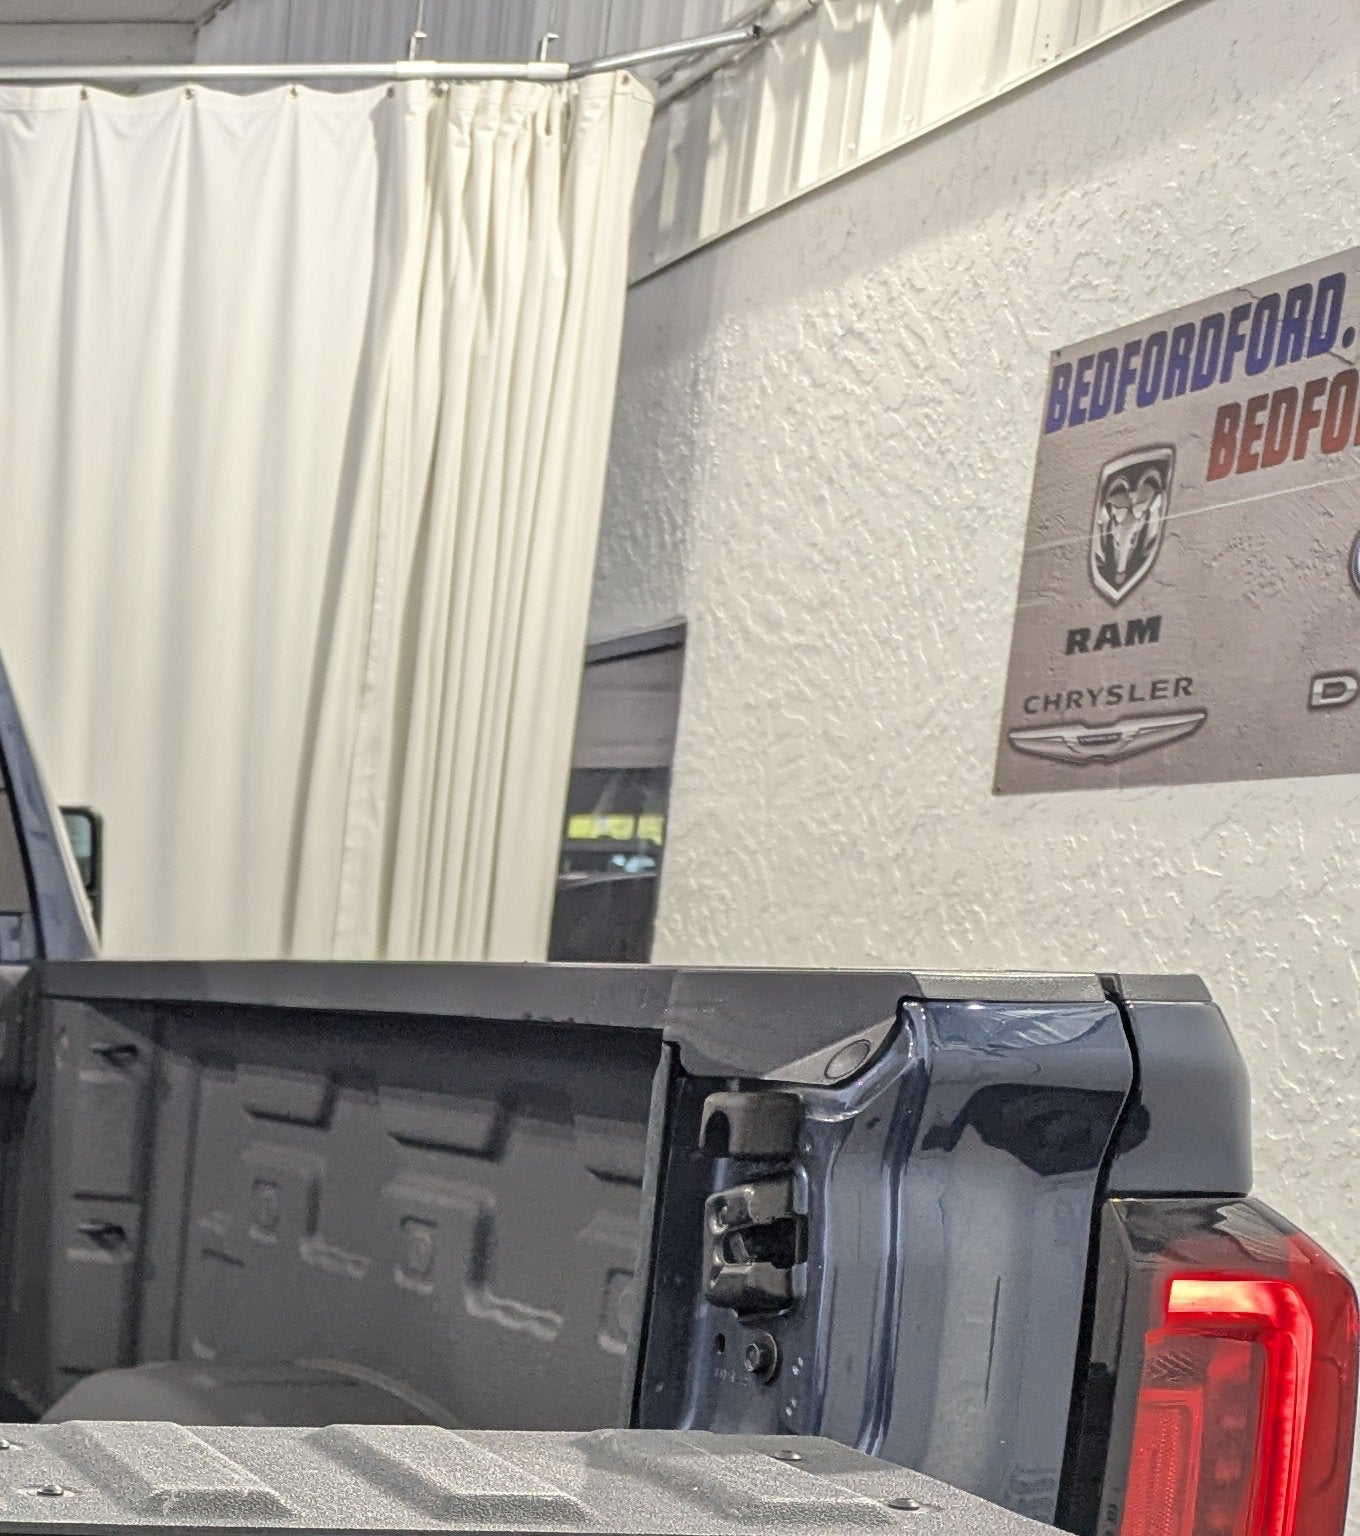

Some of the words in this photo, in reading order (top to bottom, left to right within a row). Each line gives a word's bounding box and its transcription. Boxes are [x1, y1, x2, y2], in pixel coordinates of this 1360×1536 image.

[1206, 368, 1360, 482] BEDFO
[1065, 615, 1163, 655] RAM
[1023, 676, 1194, 716] CHRYSLER
